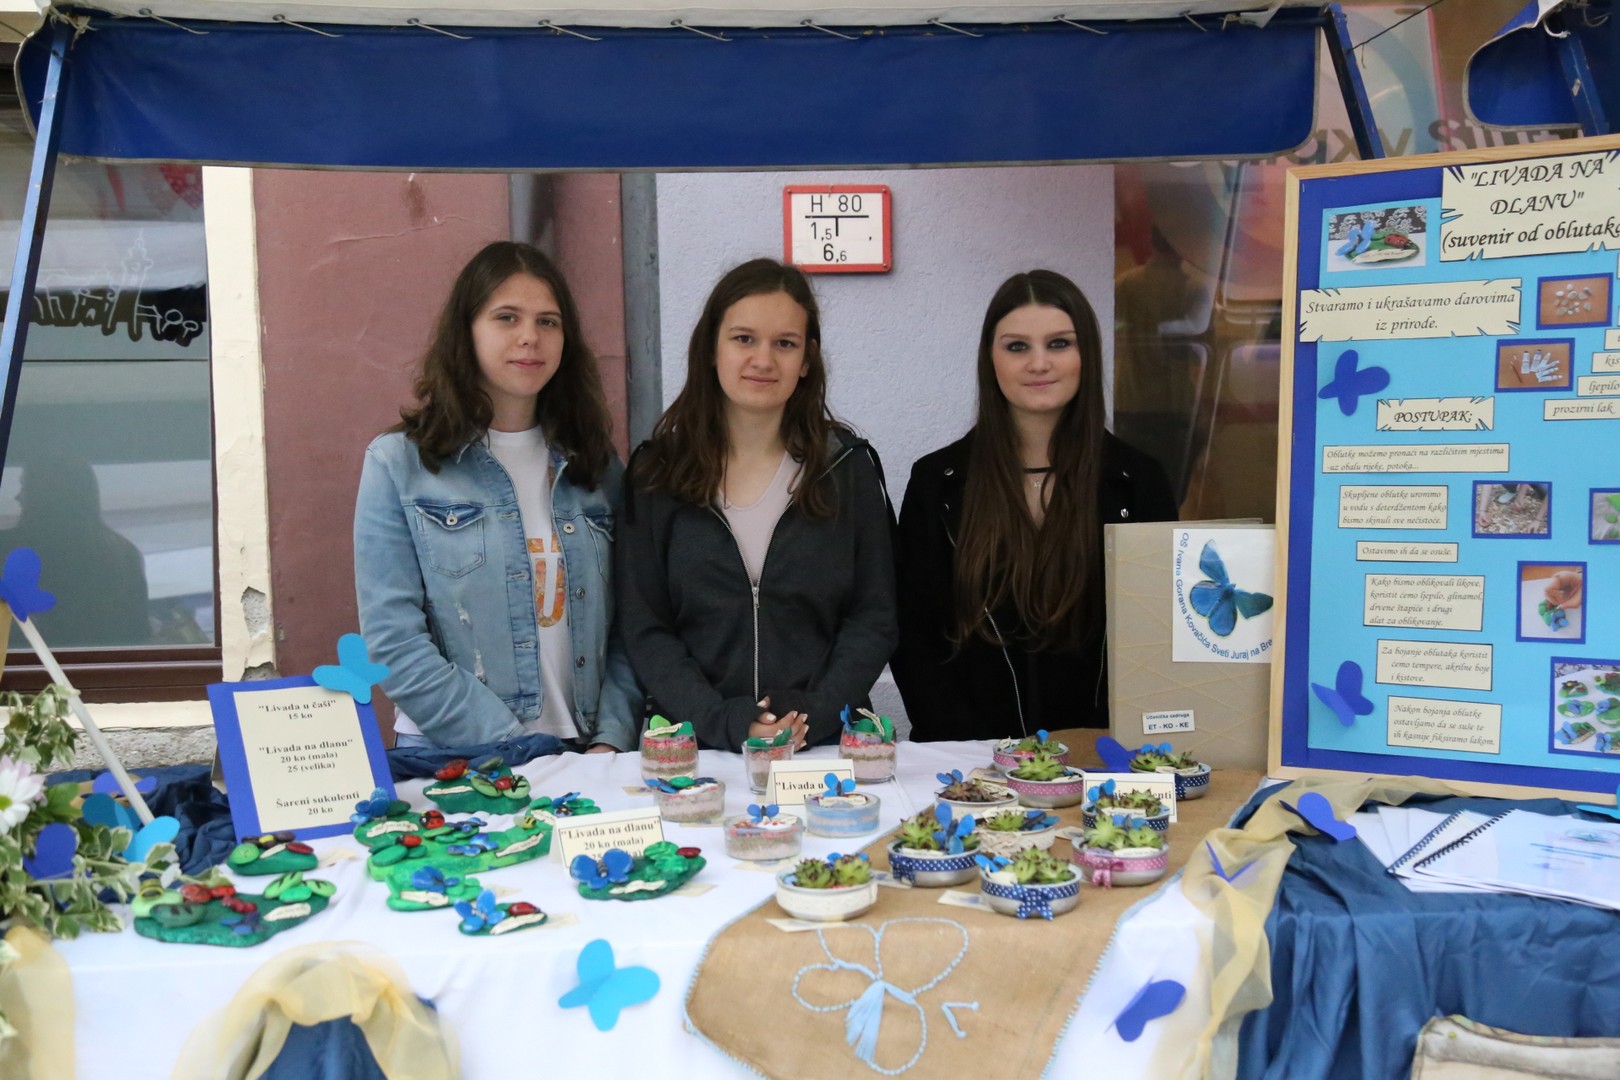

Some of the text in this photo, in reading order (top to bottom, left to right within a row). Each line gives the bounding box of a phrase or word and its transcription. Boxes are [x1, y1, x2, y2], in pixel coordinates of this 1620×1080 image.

[1471, 158, 1604, 187] "LIVADA NA
[811, 194, 862, 212] H 80
[1490, 190, 1585, 215] DLANU"
[810, 222, 833, 241] 1,5
[1442, 228, 1514, 253] (suvenir
[1518, 224, 1544, 242] od
[823, 243, 847, 263] 6,6
[1305, 292, 1515, 314] Stvaramo i ukrašavamo darovima
[1375, 316, 1438, 334] iz prirode.
[1553, 402, 1614, 416] prozirni lak
[1327, 449, 1356, 459] Oblutke
[1358, 449, 1387, 457] možemo
[1469, 447, 1504, 457] mjestima
[1341, 462, 1360, 471] obalu
[1342, 490, 1378, 500] Skupljene
[1380, 490, 1408, 500] oblutke
[1350, 503, 1368, 511] vodu
[1375, 503, 1426, 511] deterdžentom
[1427, 503, 1447, 512] kako
[1342, 516, 1364, 524] bismo
[1365, 516, 1391, 525] skinuli
[1362, 546, 1398, 555] Ostavimo
[1400, 546, 1407, 555] ih
[1409, 547, 1419, 555] da
[1371, 577, 1391, 587] Kako
[1393, 577, 1415, 586] bismo
[1416, 578, 1455, 588] oblikovali
[1370, 590, 1398, 599] koristit
[1369, 603, 1395, 612] drvene
[1431, 604, 1453, 615] drugi
[1176, 579, 1188, 615] Gorana
[1211, 643, 1230, 658] Sveti
[1231, 649, 1249, 660] Juraj
[1250, 646, 1260, 657] na
[1369, 616, 1384, 624] alat
[1398, 617, 1443, 627] oblikovanje.
[1381, 646, 1488, 659] Za bojanje oblutaka koristit
[1445, 664, 1472, 672] akrilne
[1474, 664, 1490, 675] boje
[259, 703, 300, 712] "Livada
[1394, 705, 1482, 719] Nakon bojanja oblutke
[1394, 718, 1436, 729] ostavljamo
[1437, 719, 1447, 728] da
[1394, 730, 1401, 738] ih
[1403, 730, 1430, 742] kasnije
[1430, 731, 1468, 743] fiksiramo
[259, 744, 301, 754] "Livada
[319, 739, 353, 749] dlanu"
[308, 752, 338, 760] (mala)
[288, 762, 335, 773] 25 (velika)
[776, 781, 815, 790] "Livada
[276, 791, 360, 808] Šareni sukulenti
[561, 820, 660, 839] "Livada na dlanu"
[584, 842, 595, 850] 20
[613, 837, 644, 847] (mala)
